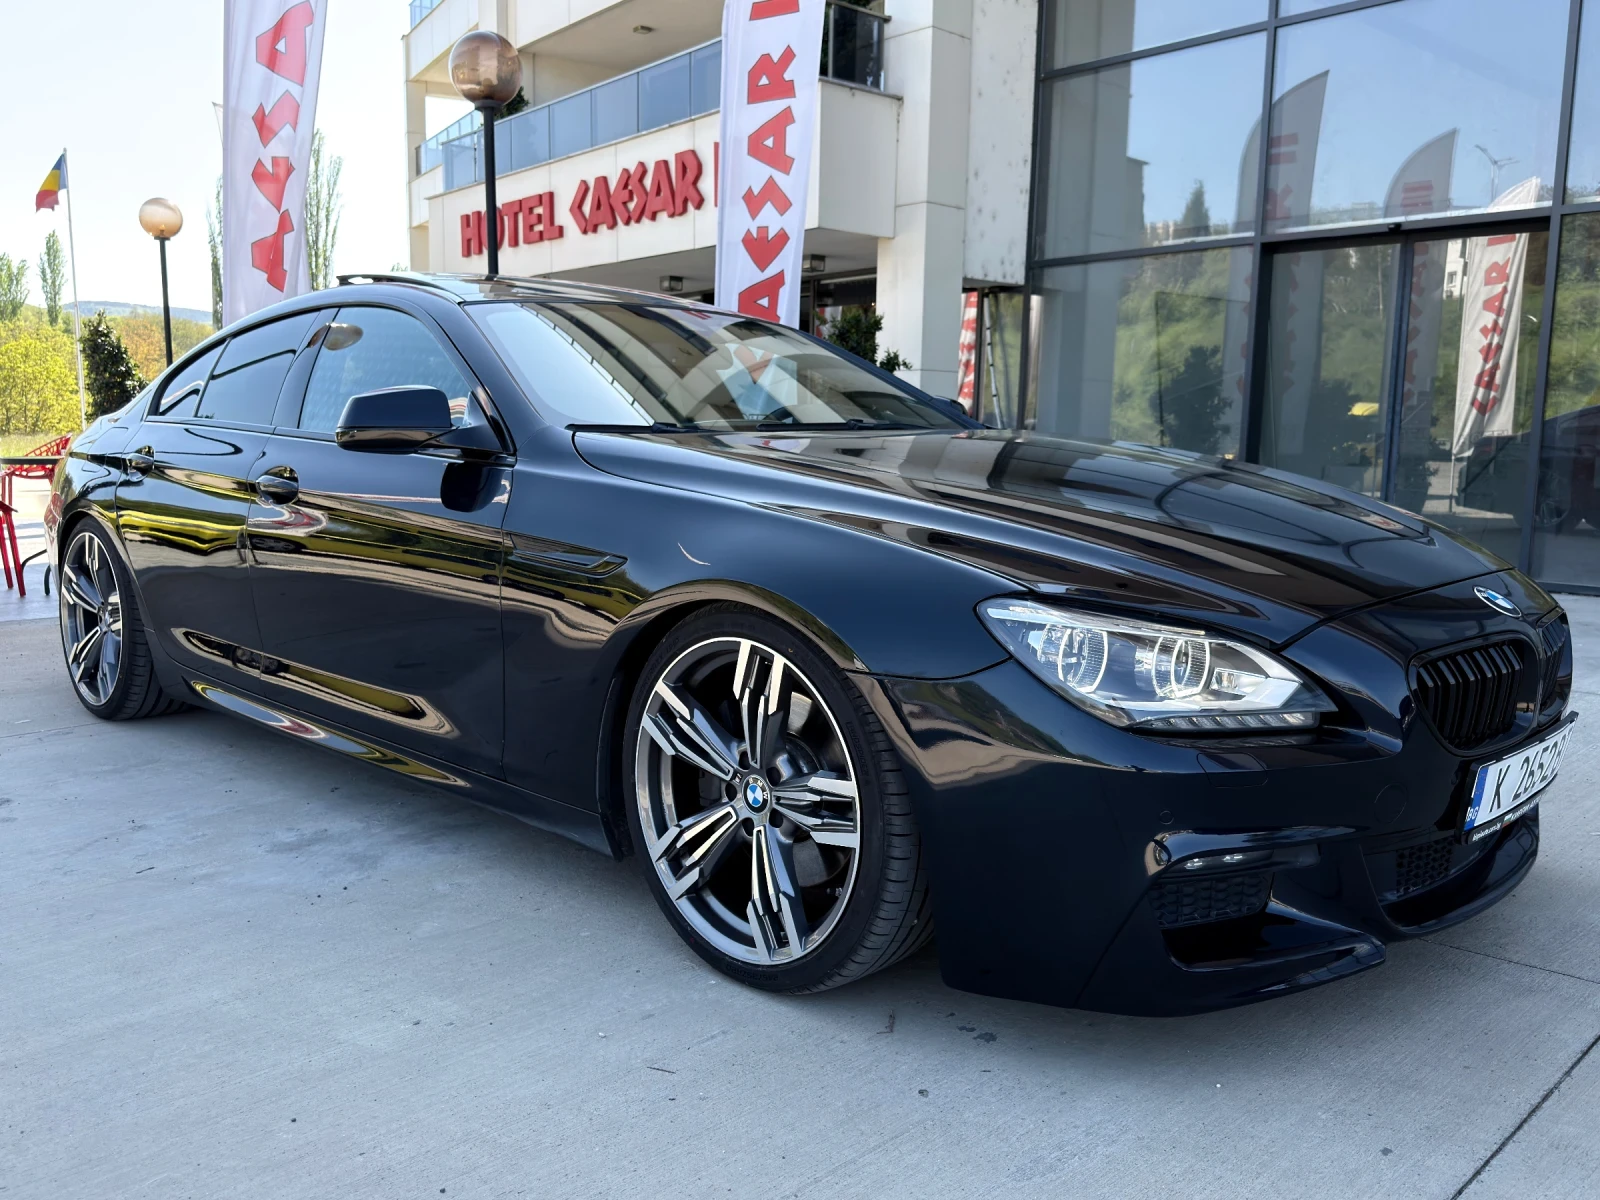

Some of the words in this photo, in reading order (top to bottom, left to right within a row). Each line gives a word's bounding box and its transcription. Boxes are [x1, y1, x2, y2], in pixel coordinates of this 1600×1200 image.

[460, 191, 564, 258] HOTEL
[569, 149, 705, 235] CAESAR
[1471, 256, 1511, 417] CAESAR
[1488, 764, 1511, 814] K
